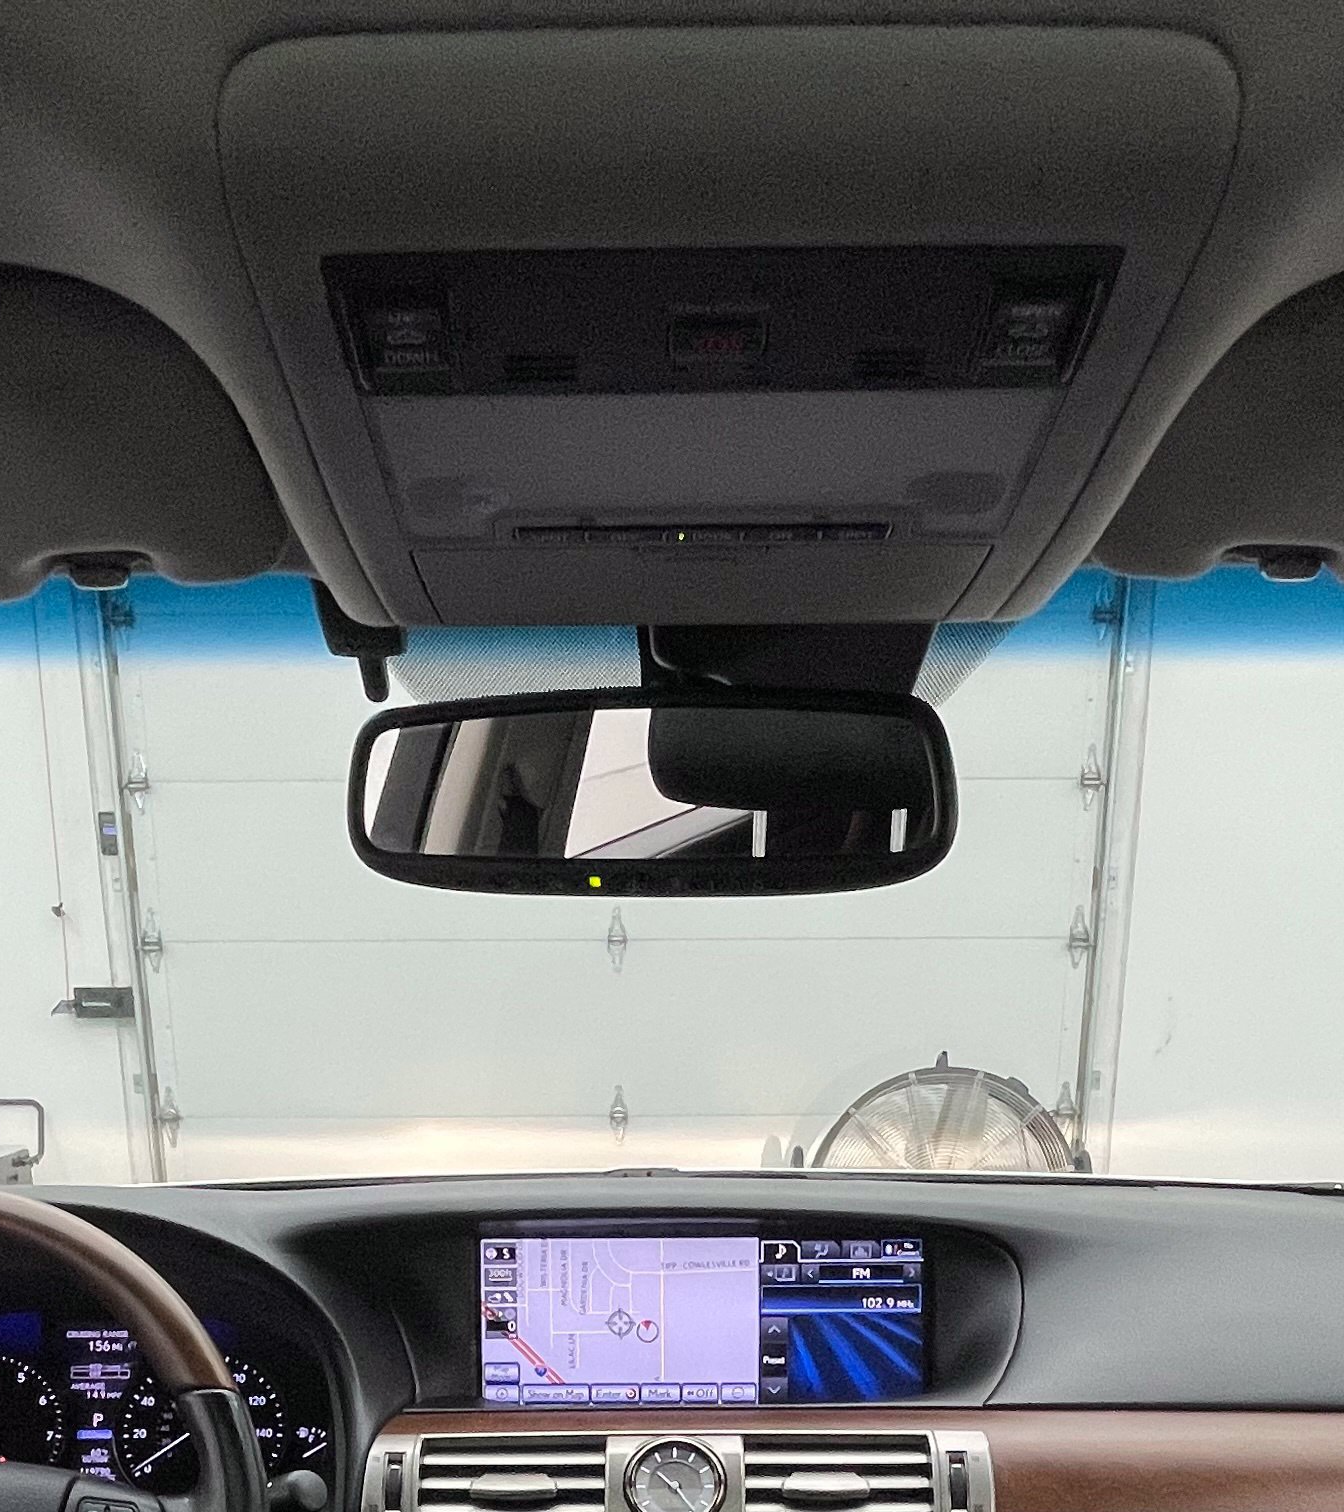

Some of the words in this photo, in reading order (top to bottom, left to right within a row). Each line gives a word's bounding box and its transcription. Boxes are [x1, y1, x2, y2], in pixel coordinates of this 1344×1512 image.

[852, 1267, 870, 1279] FM
[88, 1340, 111, 1352] 156
[17, 1372, 26, 1383] 5
[595, 1389, 621, 1399] Enter
[647, 1389, 672, 1399] Mark
[39, 1395, 48, 1406] 6
[140, 1396, 155, 1407] 40
[248, 1396, 266, 1406] 120
[92, 1412, 104, 1427] P
[45, 1430, 55, 1441] 7
[133, 1428, 147, 1439] 20
[255, 1428, 273, 1438] 140
